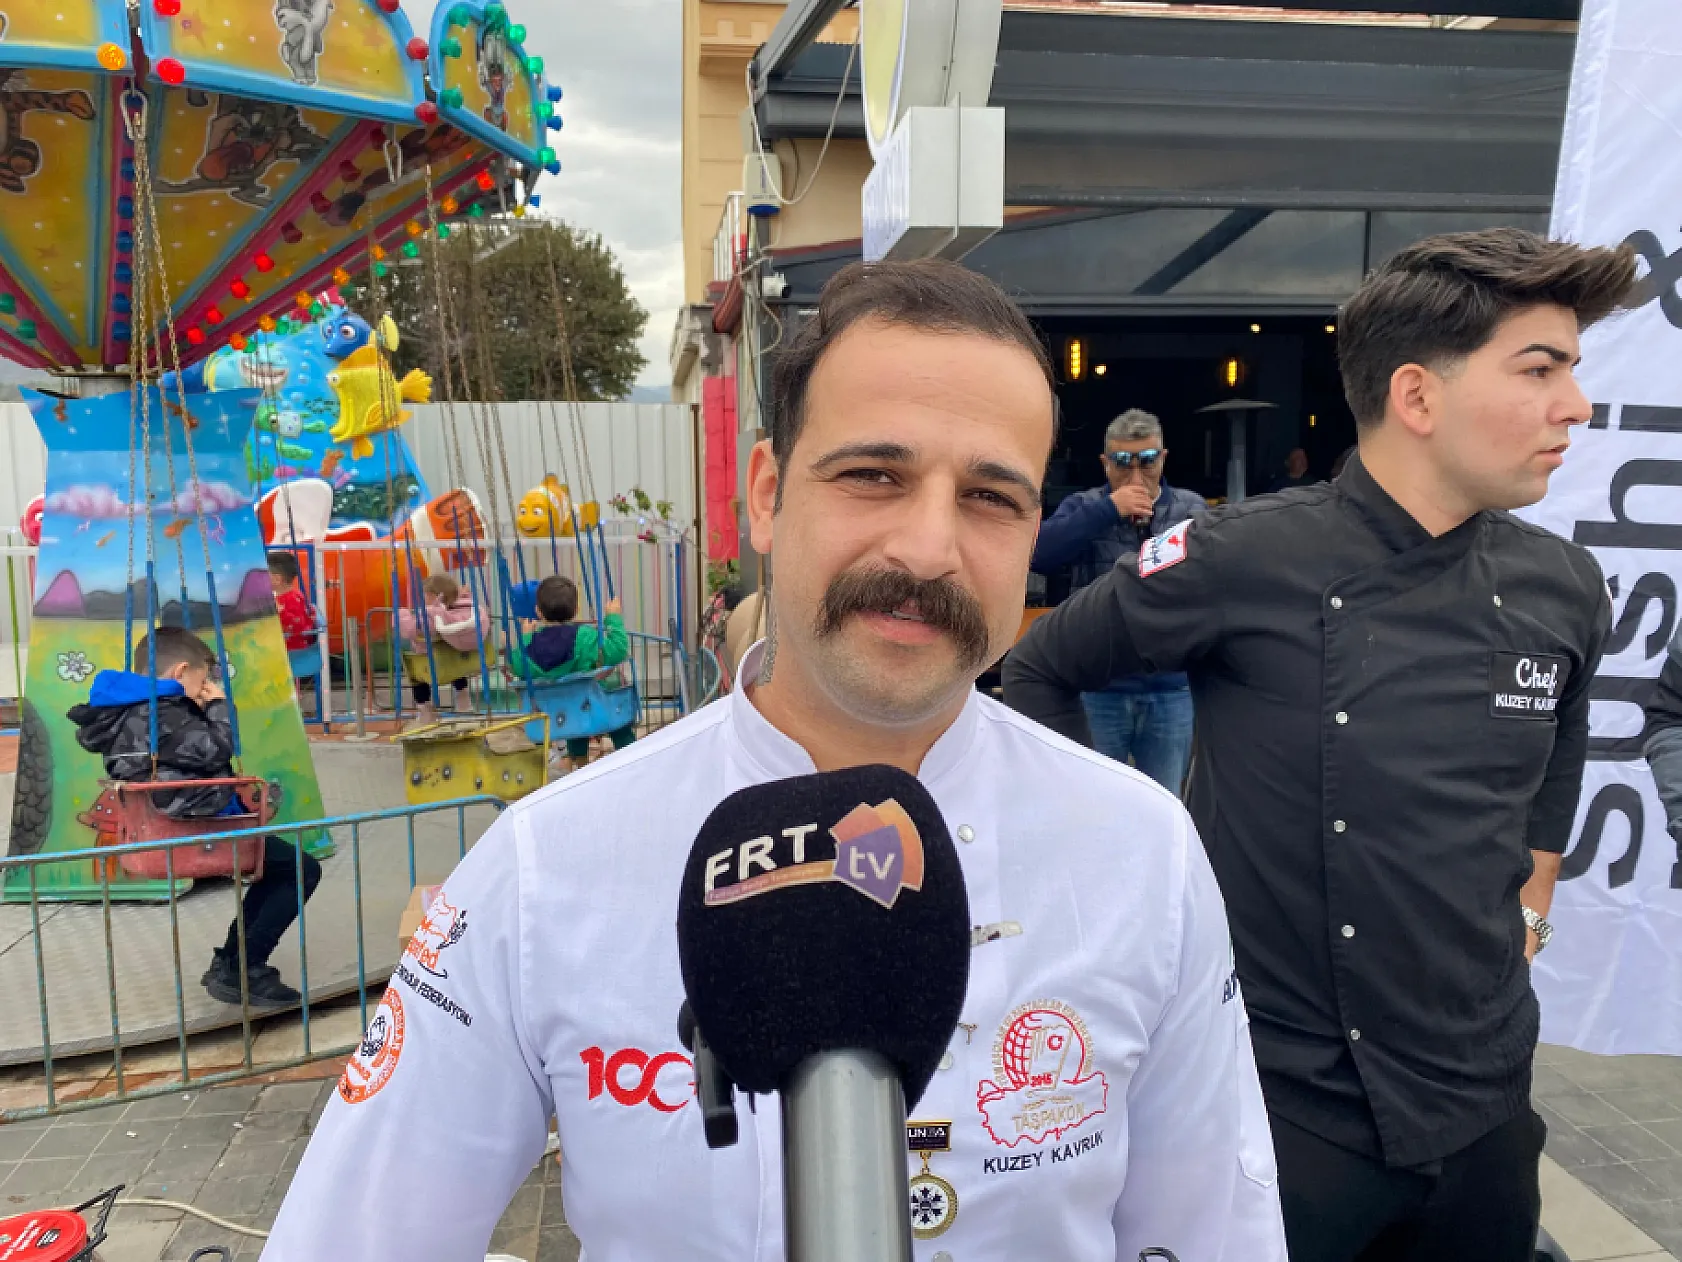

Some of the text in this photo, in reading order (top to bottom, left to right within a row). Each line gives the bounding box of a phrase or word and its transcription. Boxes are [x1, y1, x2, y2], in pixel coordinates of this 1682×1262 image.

[1515, 658, 1558, 696] Chef
[1495, 693, 1533, 709] KUZEY
[704, 823, 818, 894] FRT
[849, 845, 896, 880] tv
[984, 1130, 1104, 1174] KUZEY KAVRUK
